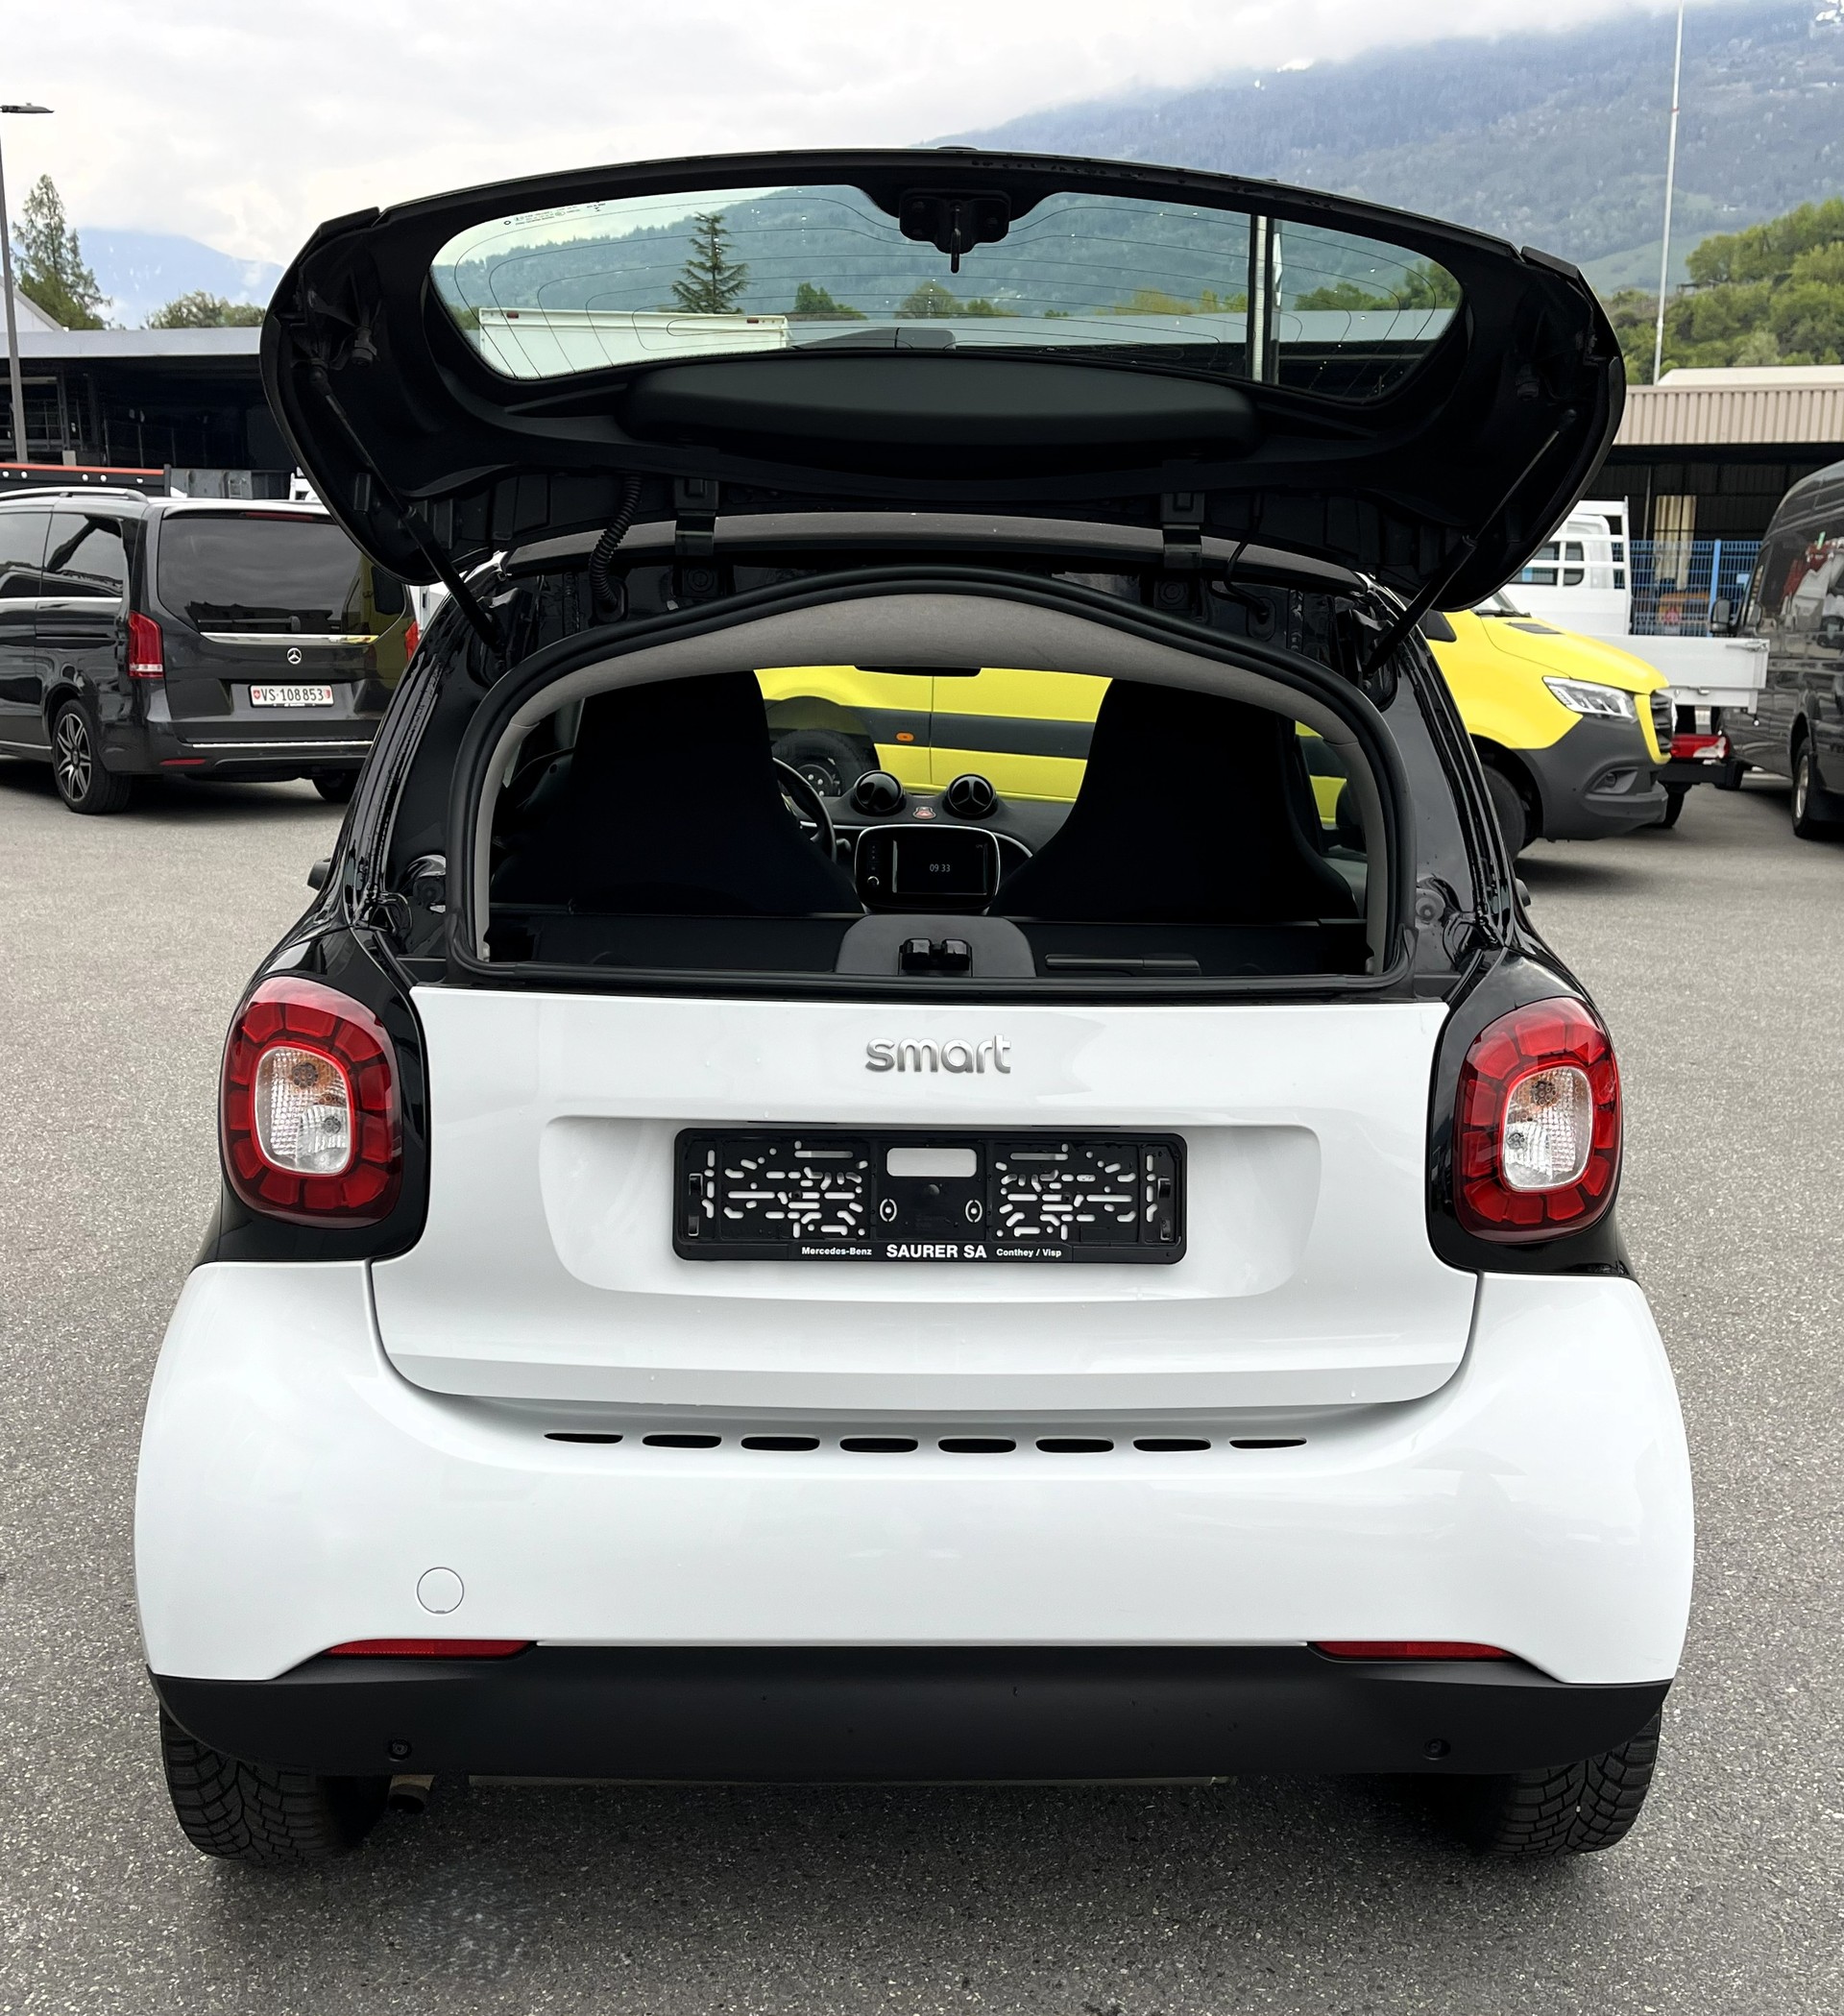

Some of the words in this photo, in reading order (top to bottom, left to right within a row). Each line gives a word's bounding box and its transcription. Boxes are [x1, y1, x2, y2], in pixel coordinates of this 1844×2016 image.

[865, 1034, 1011, 1074] smart
[801, 1246, 872, 1255] Mercedes-Benz
[886, 1244, 958, 1258] SAURER
[963, 1244, 987, 1258] SA
[996, 1248, 1034, 1258] Conthey
[1042, 1248, 1062, 1258] Visp
